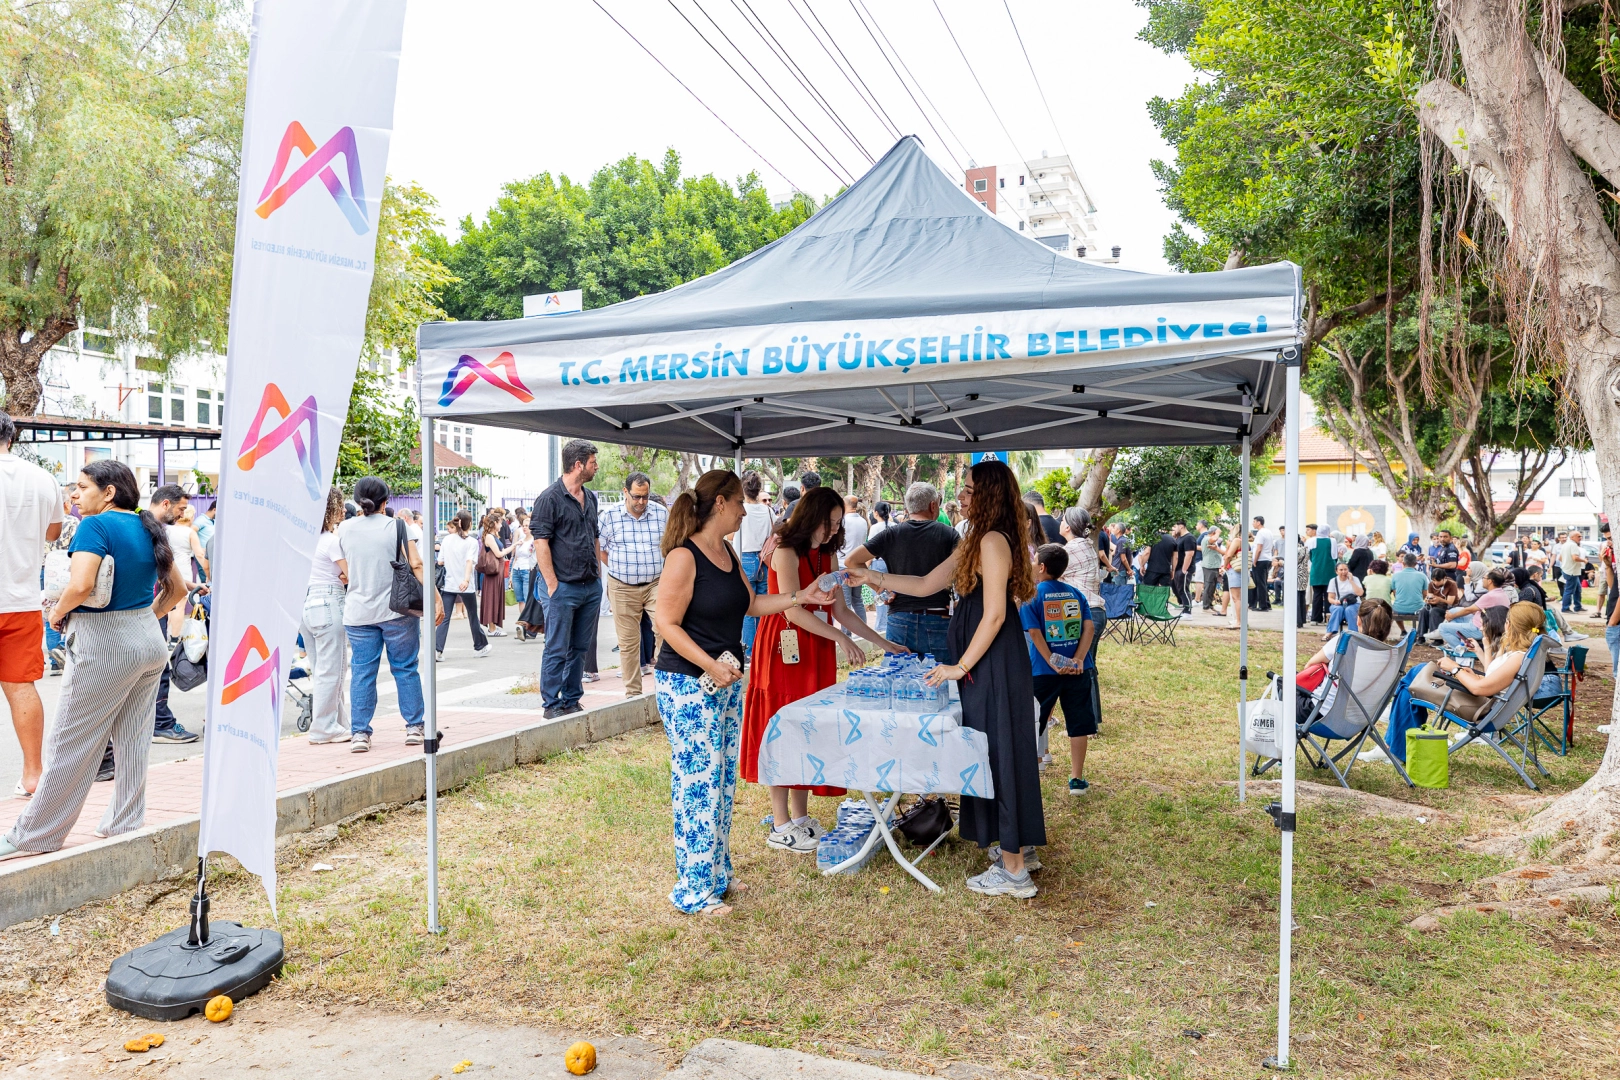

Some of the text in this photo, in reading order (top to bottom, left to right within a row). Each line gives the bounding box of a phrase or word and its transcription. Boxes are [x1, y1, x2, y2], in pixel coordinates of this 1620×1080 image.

[559, 314, 1268, 387] T.C. MERSİN BÜYÜKŞEHİR BELEDİYESİ
